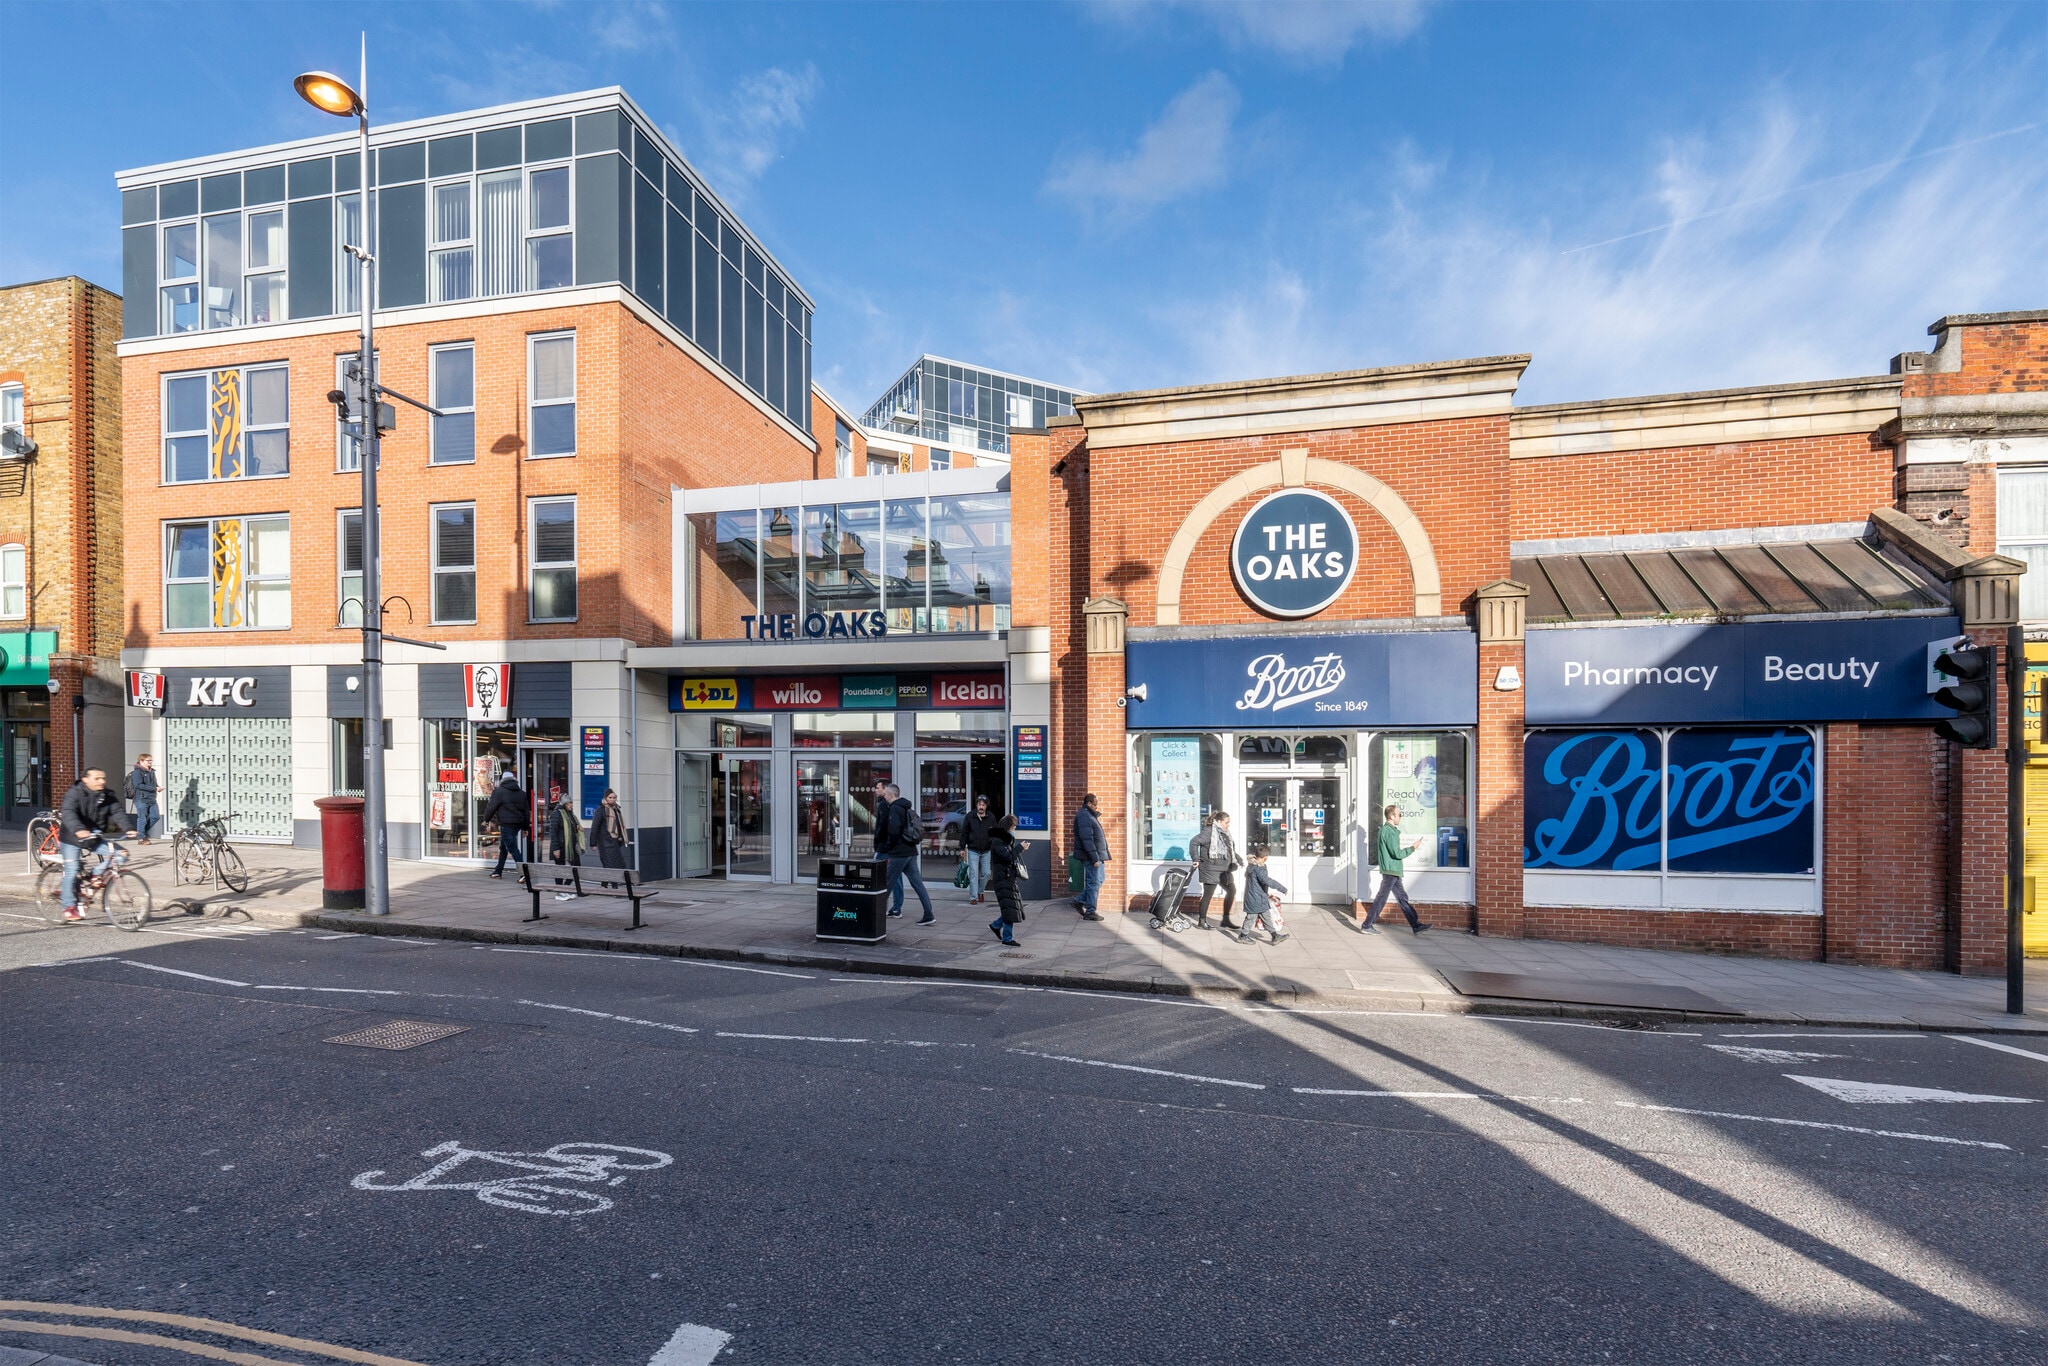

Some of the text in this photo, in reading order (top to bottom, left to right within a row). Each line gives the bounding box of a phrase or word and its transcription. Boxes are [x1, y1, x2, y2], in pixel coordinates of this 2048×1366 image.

[1263, 523, 1327, 551] THE
[1247, 551, 1344, 581] OAKS
[741, 611, 888, 639] THE OAKS
[1235, 653, 1346, 712] Boots
[1564, 655, 1880, 691] Pharmacy Beauty
[187, 677, 256, 706] KFC
[772, 682, 822, 704] wilko
[843, 687, 884, 696] Poundland
[941, 681, 1006, 700] Icelan
[138, 699, 159, 707] KFC
[1315, 701, 1368, 712] Since 1849
[1162, 740, 1187, 749] Click &
[1387, 788, 1422, 800] Ready
[1523, 729, 1815, 870] Boots
[832, 911, 857, 920] ACTON
